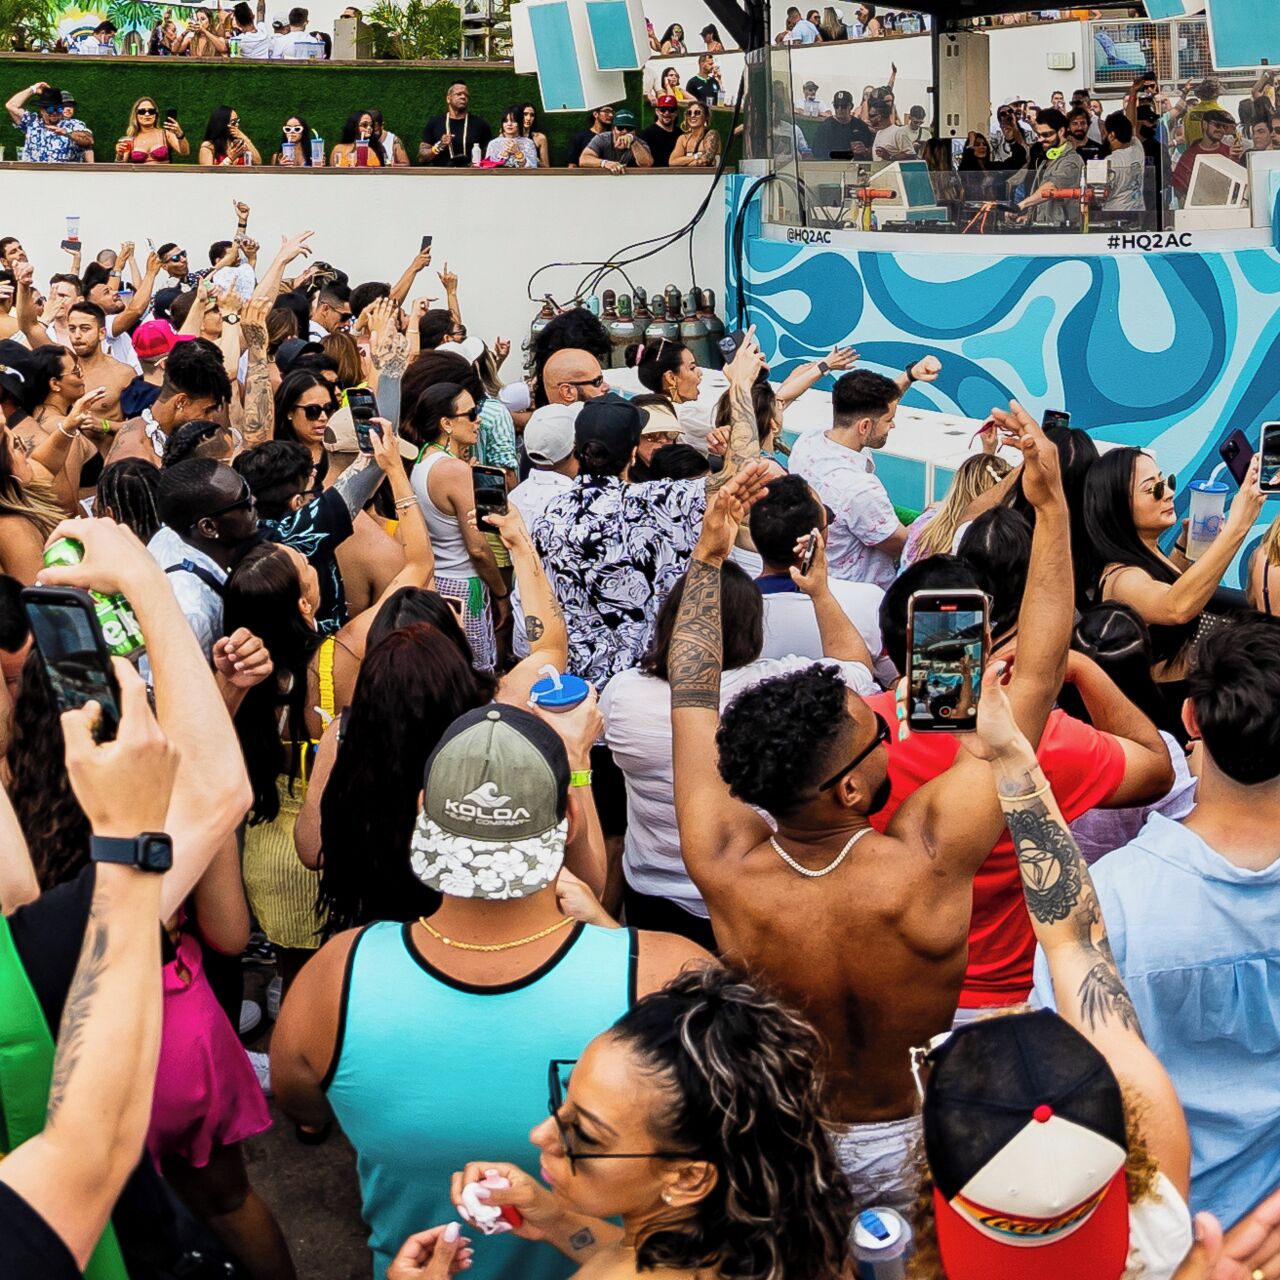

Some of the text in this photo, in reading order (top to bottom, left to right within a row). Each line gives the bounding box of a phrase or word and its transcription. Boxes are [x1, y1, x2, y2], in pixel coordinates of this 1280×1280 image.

[786, 227, 832, 245] @HQ2AC
[1107, 232, 1193, 252] #HQ2AC
[445, 798, 531, 820] KOLOA
